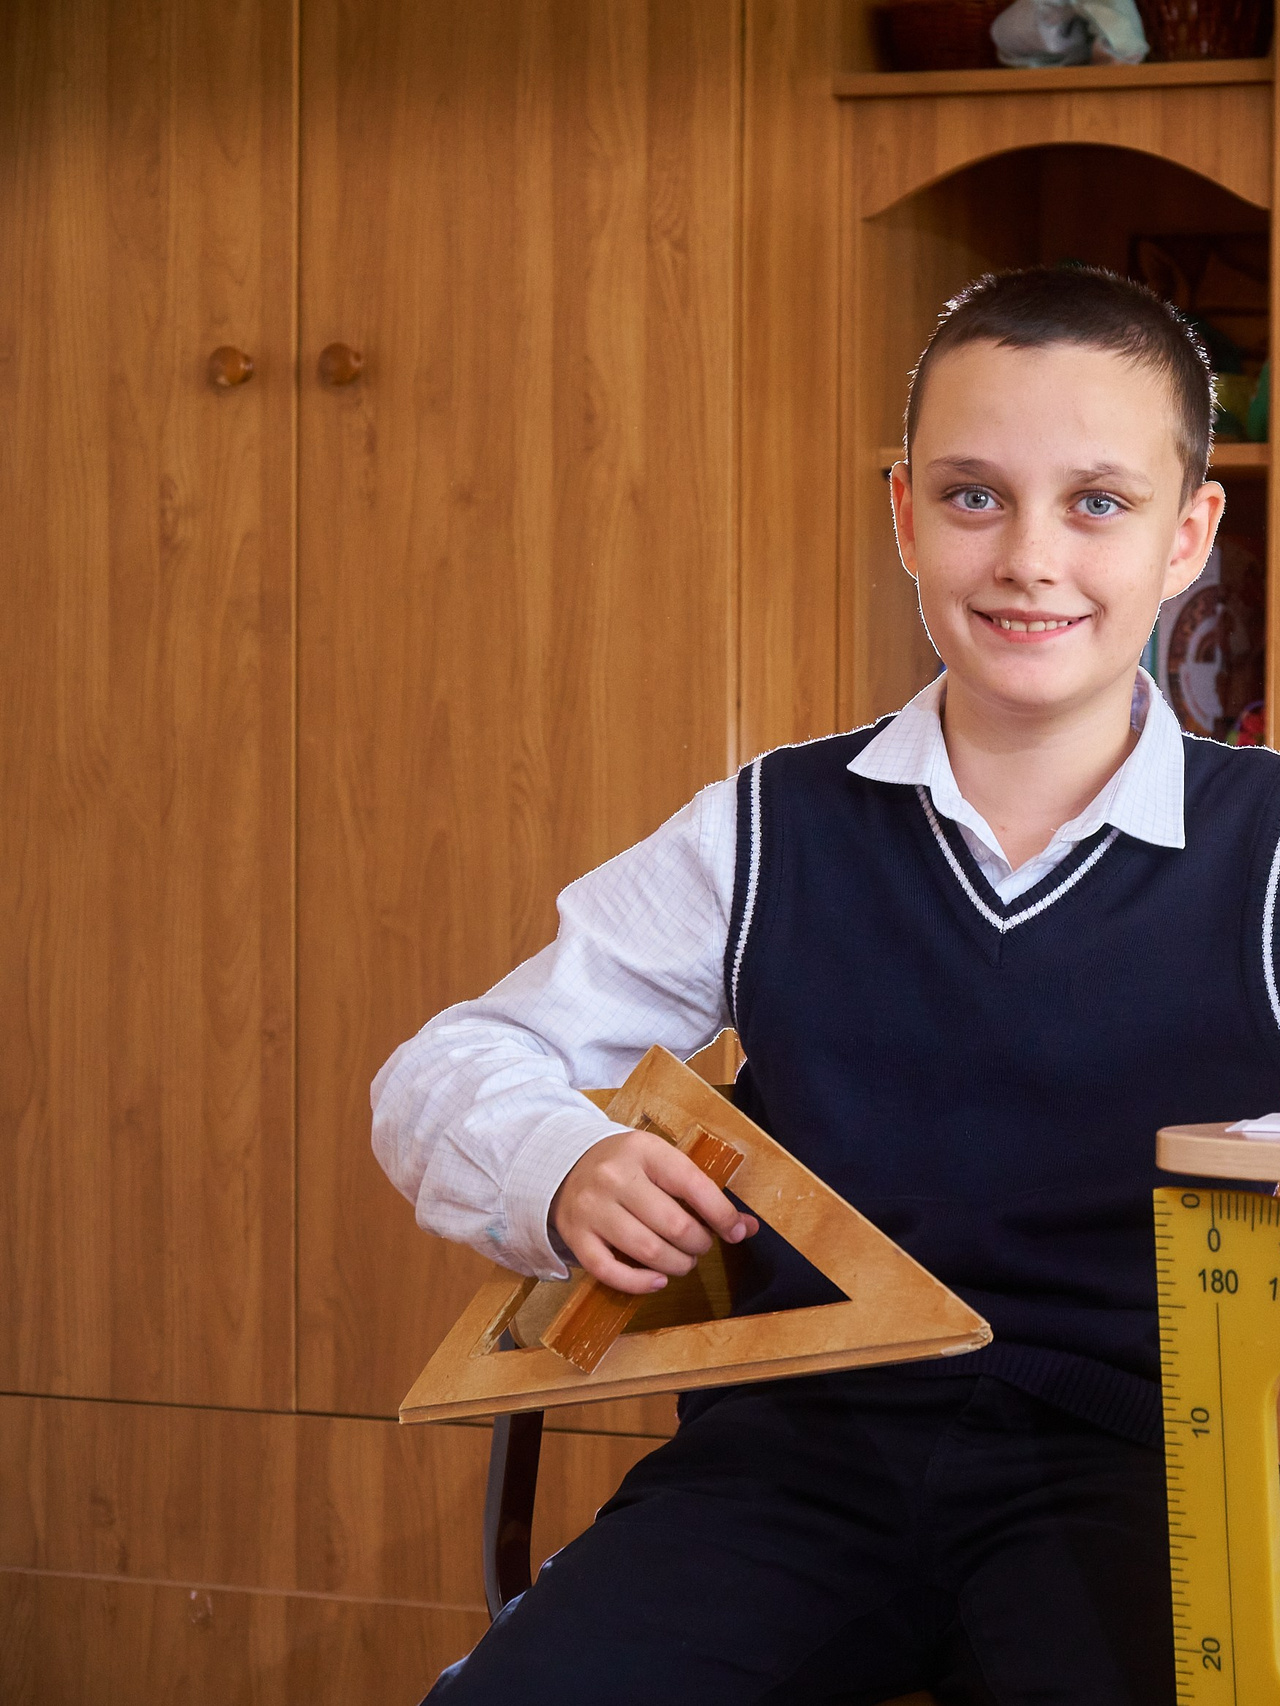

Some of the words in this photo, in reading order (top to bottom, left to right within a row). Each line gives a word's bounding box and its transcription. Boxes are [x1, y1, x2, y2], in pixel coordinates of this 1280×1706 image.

[1207, 1227, 1221, 1253] 0
[1197, 1268, 1239, 1295] 180
[1190, 1406, 1211, 1440] 10
[1201, 1635, 1223, 1673] 20
